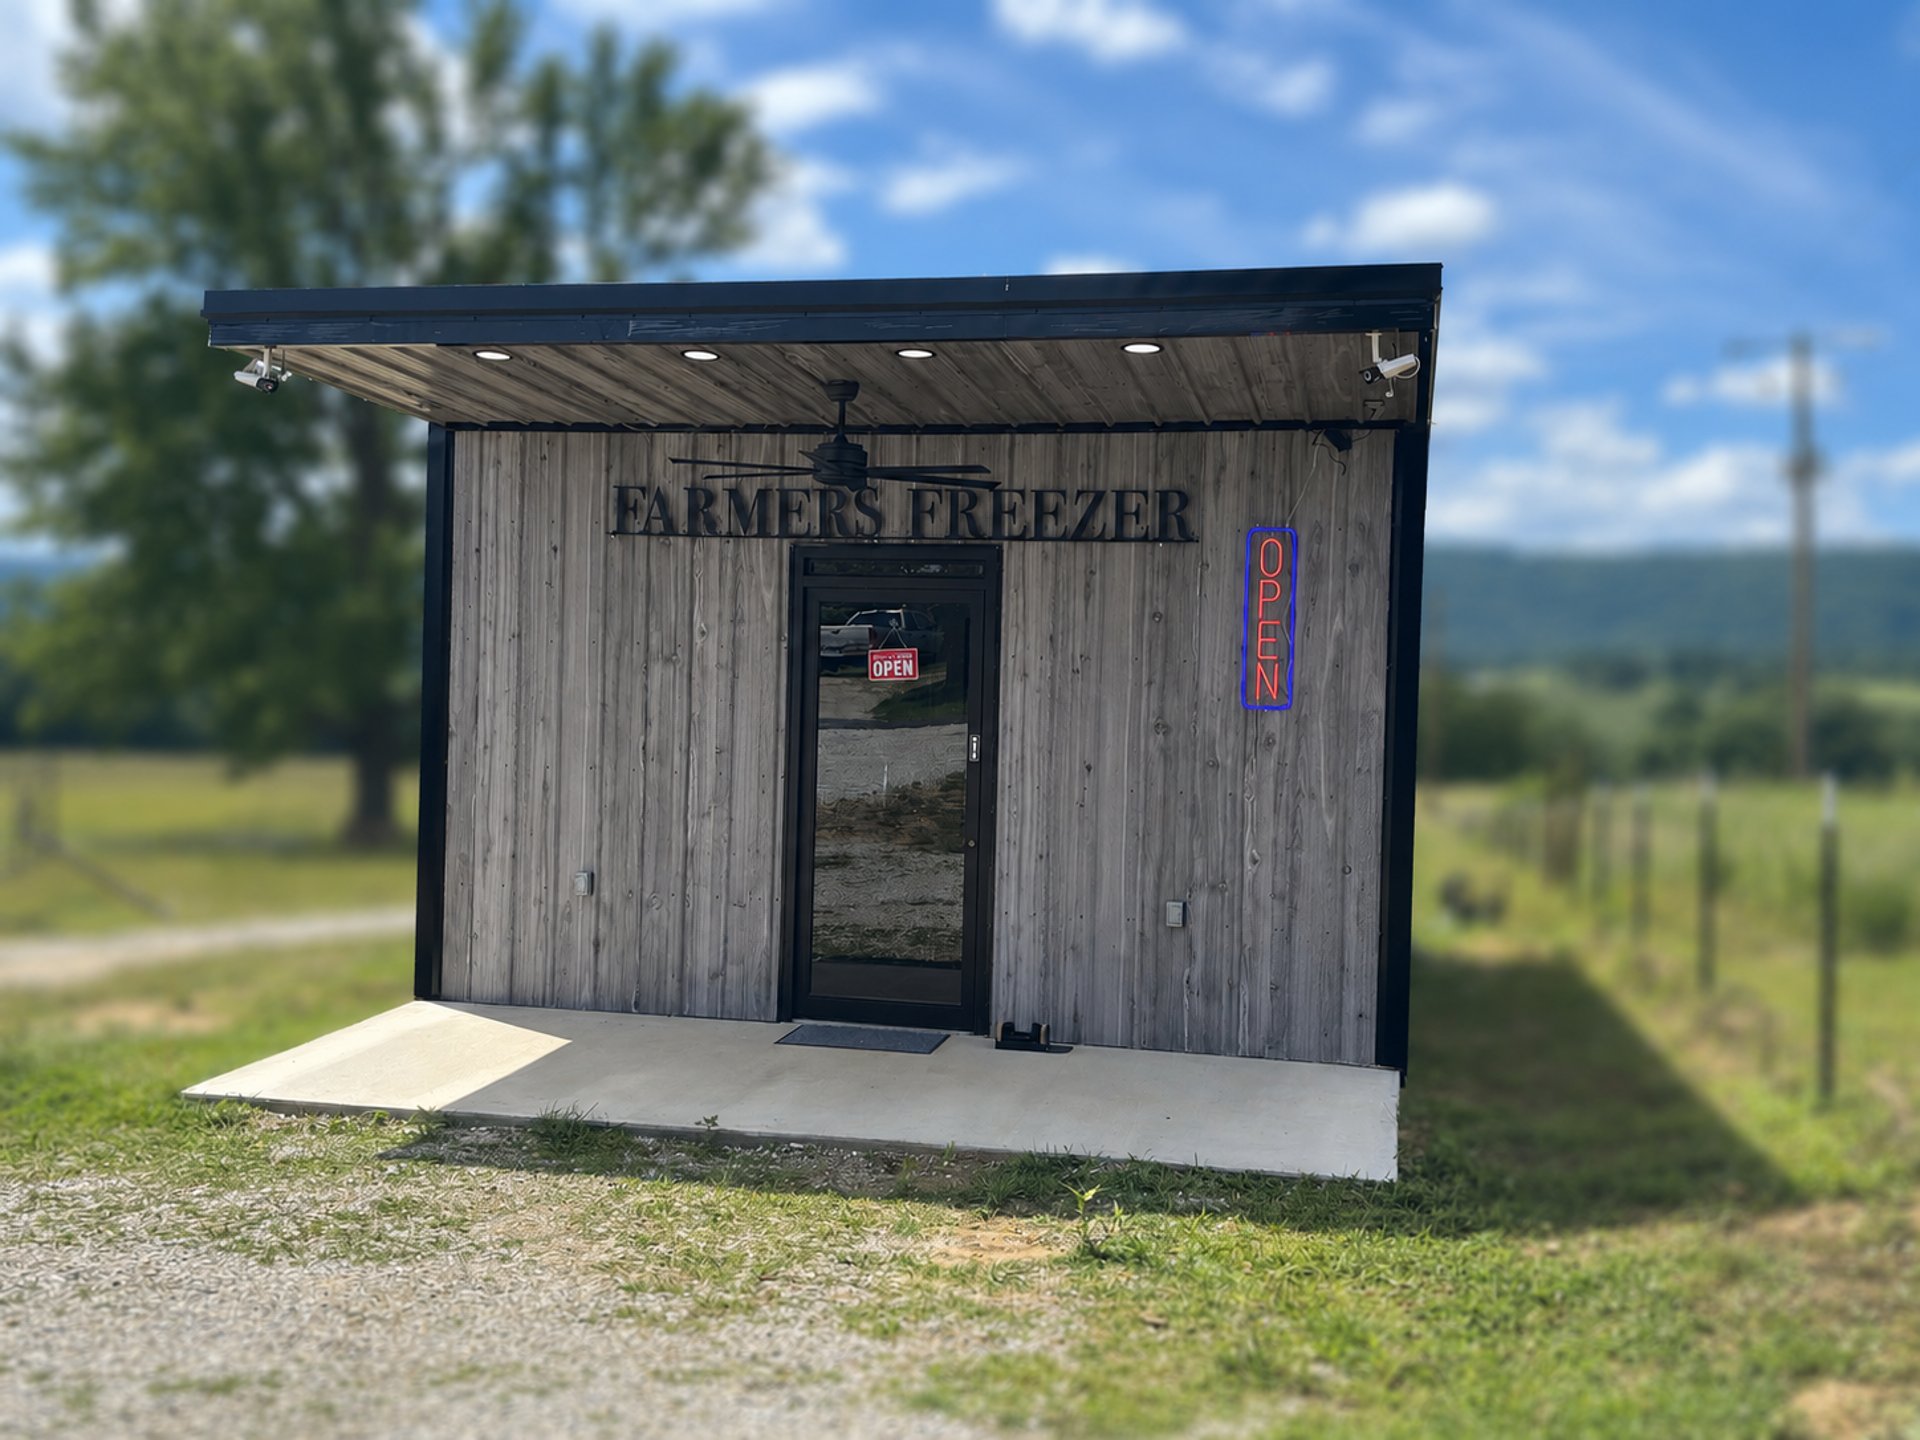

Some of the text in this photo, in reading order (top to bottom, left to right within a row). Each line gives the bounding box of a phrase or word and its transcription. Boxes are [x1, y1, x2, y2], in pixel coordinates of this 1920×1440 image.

[612, 485, 1196, 542] FARMERS FREEZER
[1255, 537, 1284, 701] OPEN
[874, 660, 913, 677] OPEN
